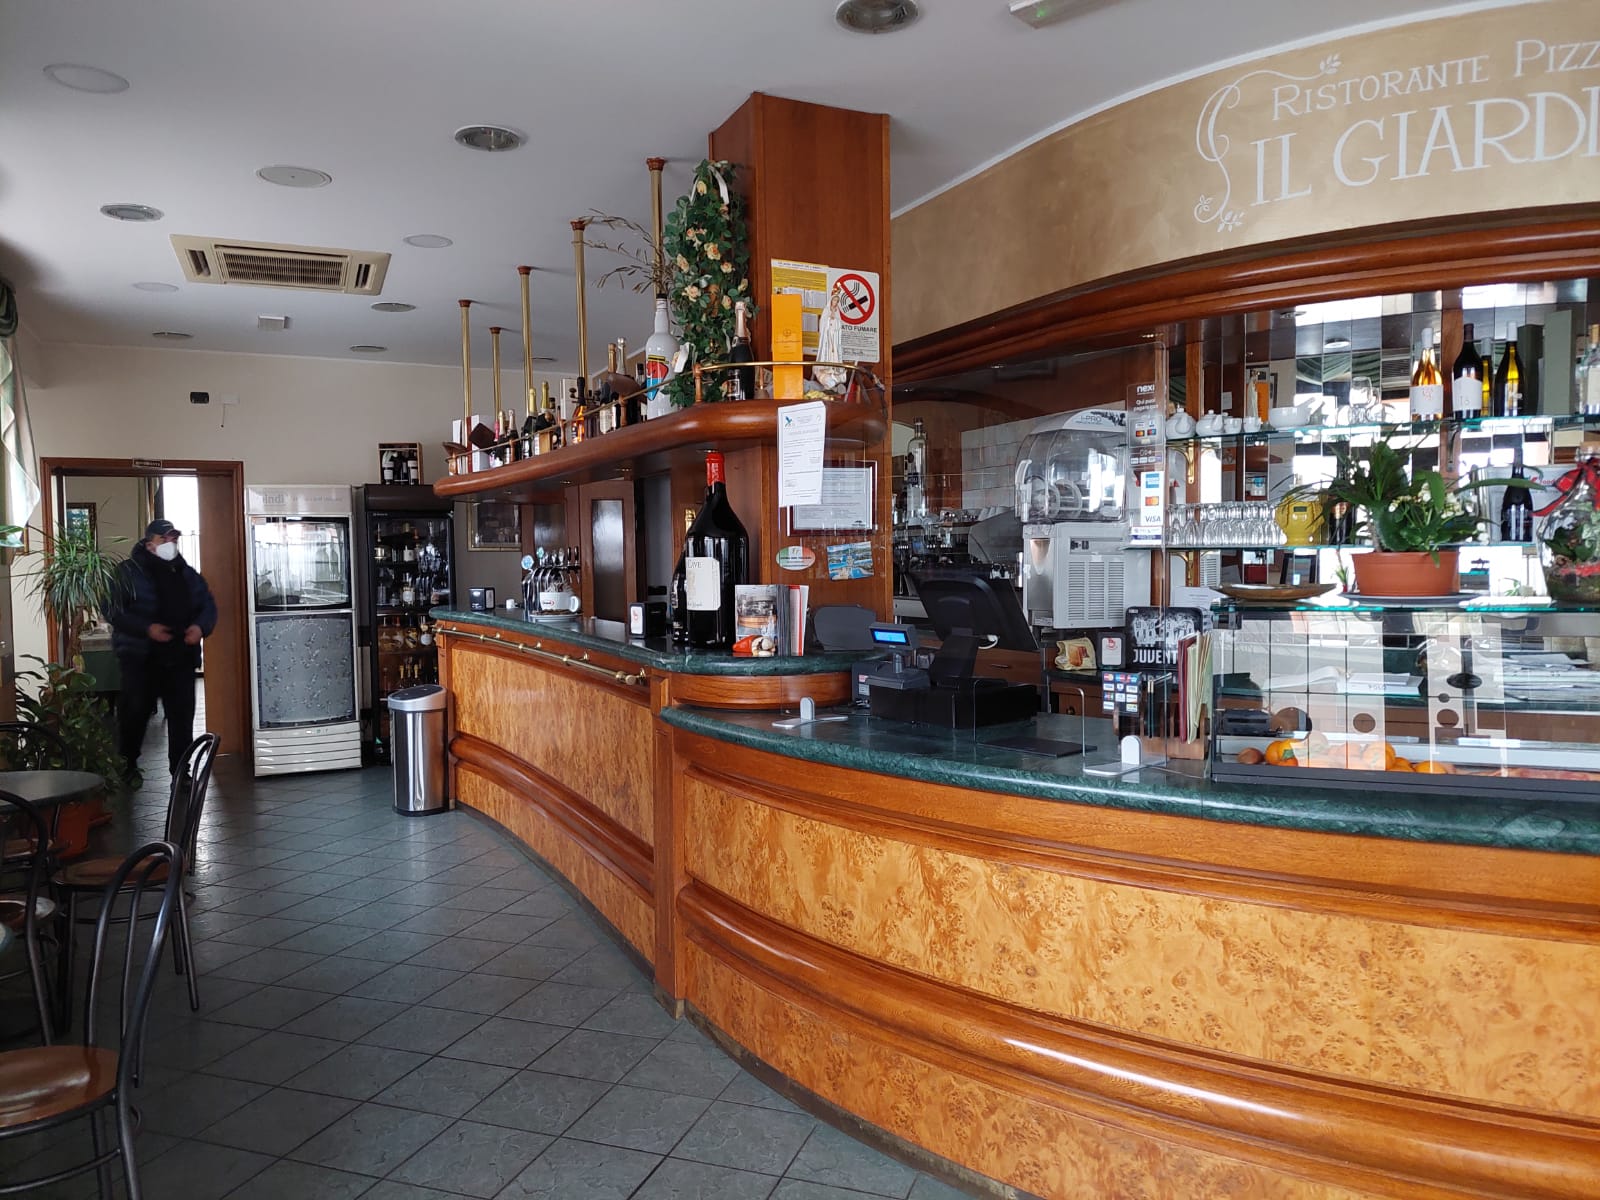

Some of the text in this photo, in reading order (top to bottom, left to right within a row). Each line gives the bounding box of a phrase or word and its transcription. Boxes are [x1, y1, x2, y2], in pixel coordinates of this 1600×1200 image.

[1271, 38, 1600, 120] RISTORANTE PIZZ
[1250, 86, 1600, 207] IL GIARDI
[853, 325, 878, 333] FUMARE
[1137, 384, 1154, 392] nexi
[1145, 515, 1161, 523] VISA
